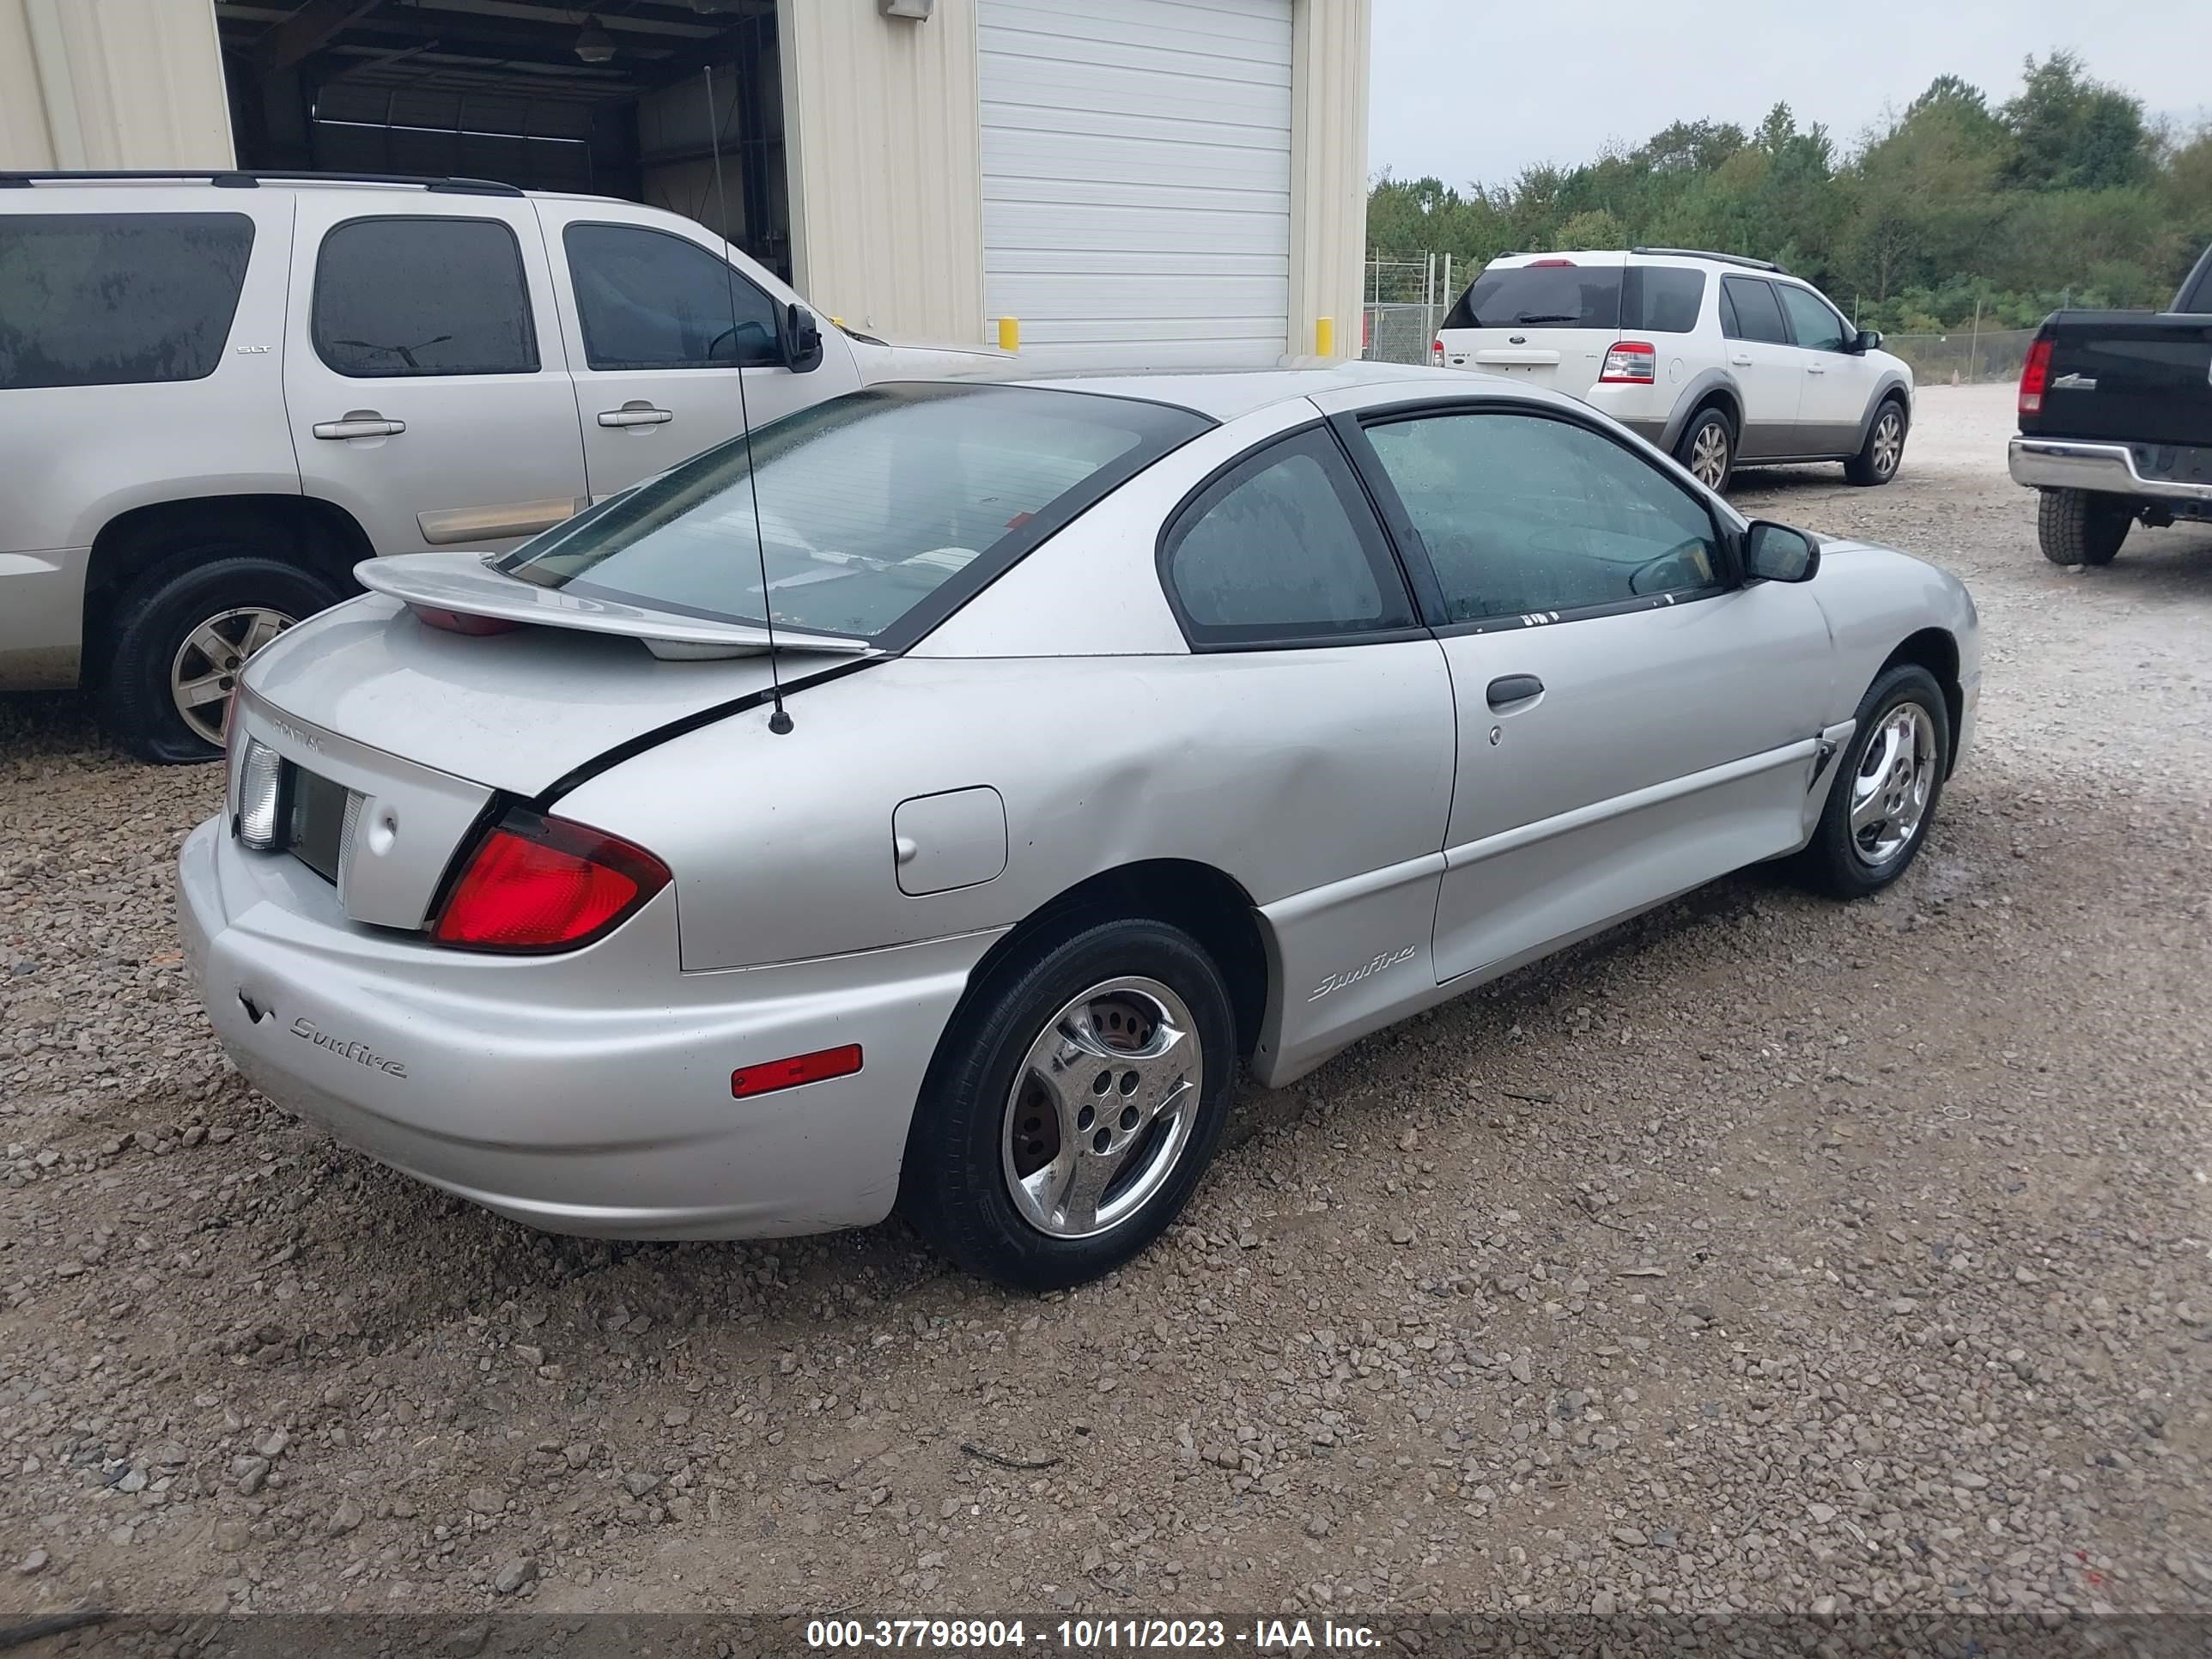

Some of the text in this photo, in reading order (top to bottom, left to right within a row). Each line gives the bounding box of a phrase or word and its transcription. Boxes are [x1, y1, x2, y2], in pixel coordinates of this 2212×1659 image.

[237, 345, 271, 355] SLT
[1307, 944, 1416, 1003] Sunfire
[289, 1018, 410, 1079] Sunfire
